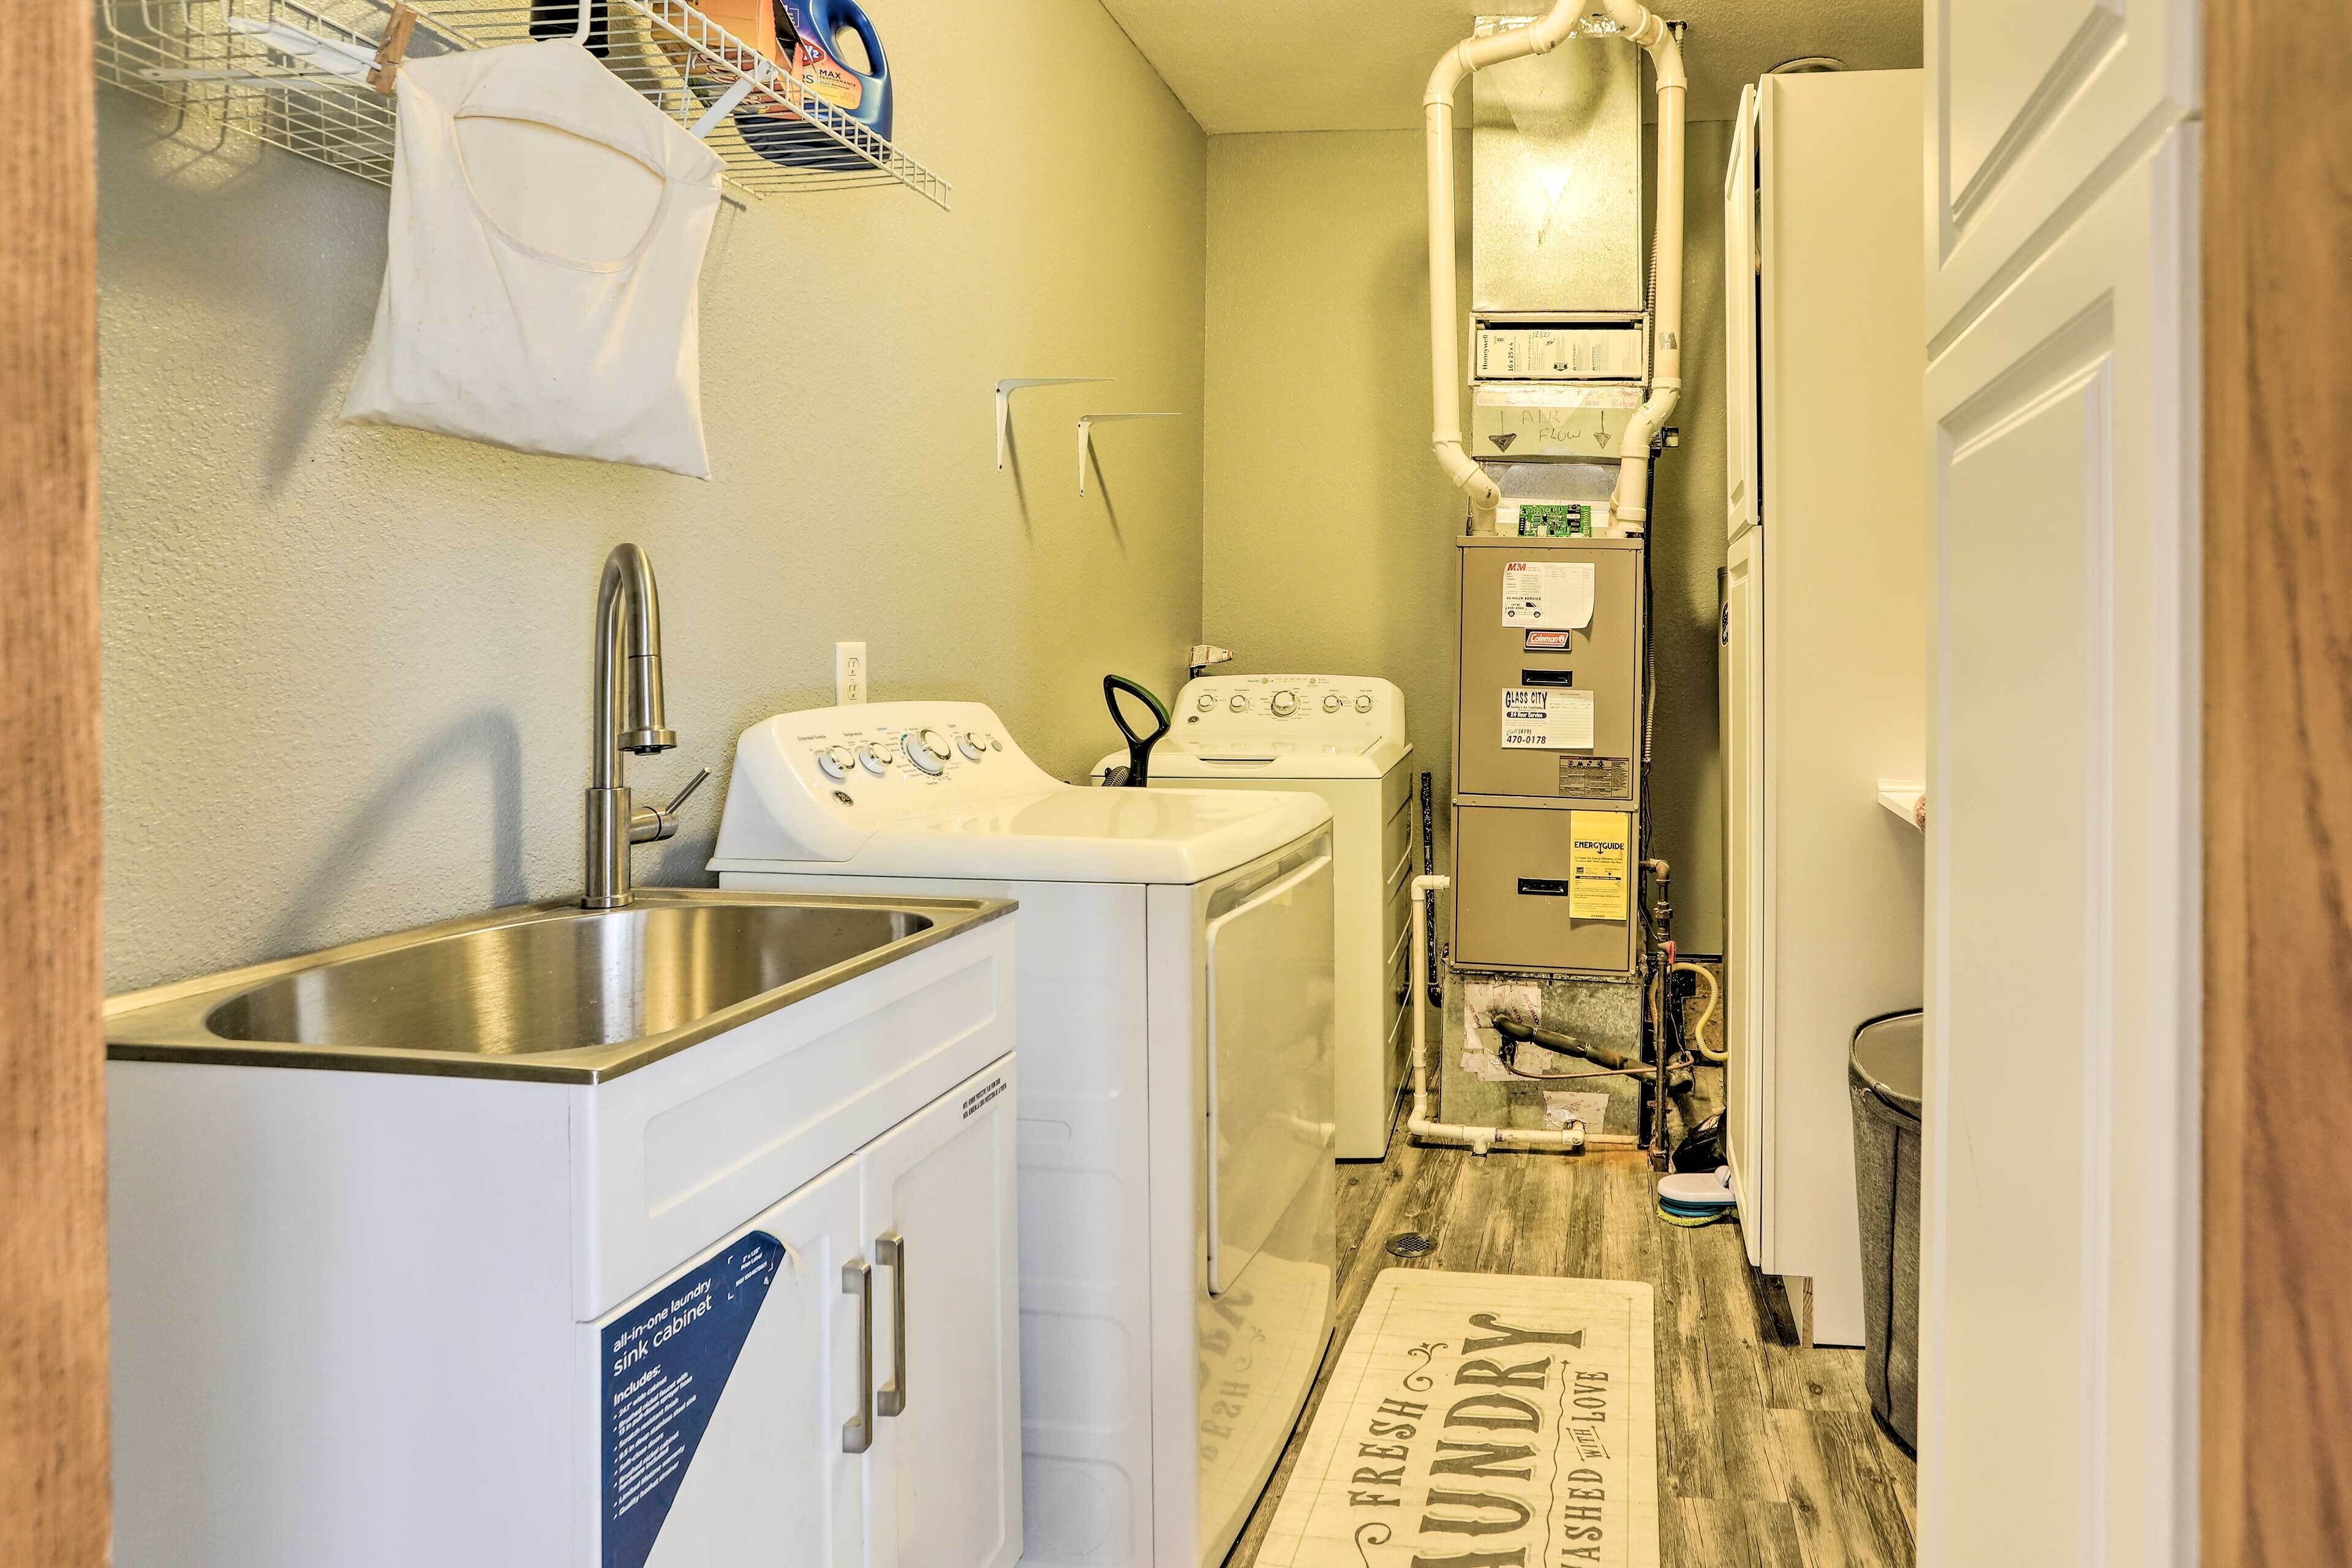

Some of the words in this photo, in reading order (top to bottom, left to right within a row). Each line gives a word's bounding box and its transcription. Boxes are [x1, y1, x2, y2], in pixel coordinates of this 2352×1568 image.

[820, 69, 841, 79] MAX
[820, 76, 856, 86] PERFORMANCE
[1522, 410, 1561, 424] AIR
[1539, 428, 1581, 442] FLOW
[1530, 633, 1559, 643] Coleman
[1506, 691, 1528, 708] GLASS
[1531, 691, 1547, 709] CITY
[1507, 736, 1547, 744] 470-0178
[1574, 841, 1625, 851] ENERGYGUIDE
[613, 1307, 669, 1353] all-in-one
[671, 1278, 712, 1314] laundry
[613, 1339, 649, 1377] sink
[653, 1294, 712, 1348] cabinet
[614, 1364, 662, 1408] Includes:
[647, 1376, 667, 1395] cabinet
[1571, 1371, 1609, 1423] LOVE
[1410, 1313, 1584, 1568] AUNDRY
[1574, 1428, 1603, 1458] WITH
[1348, 1398, 1428, 1507] FRESH
[1561, 1468, 1605, 1568] ASHED
